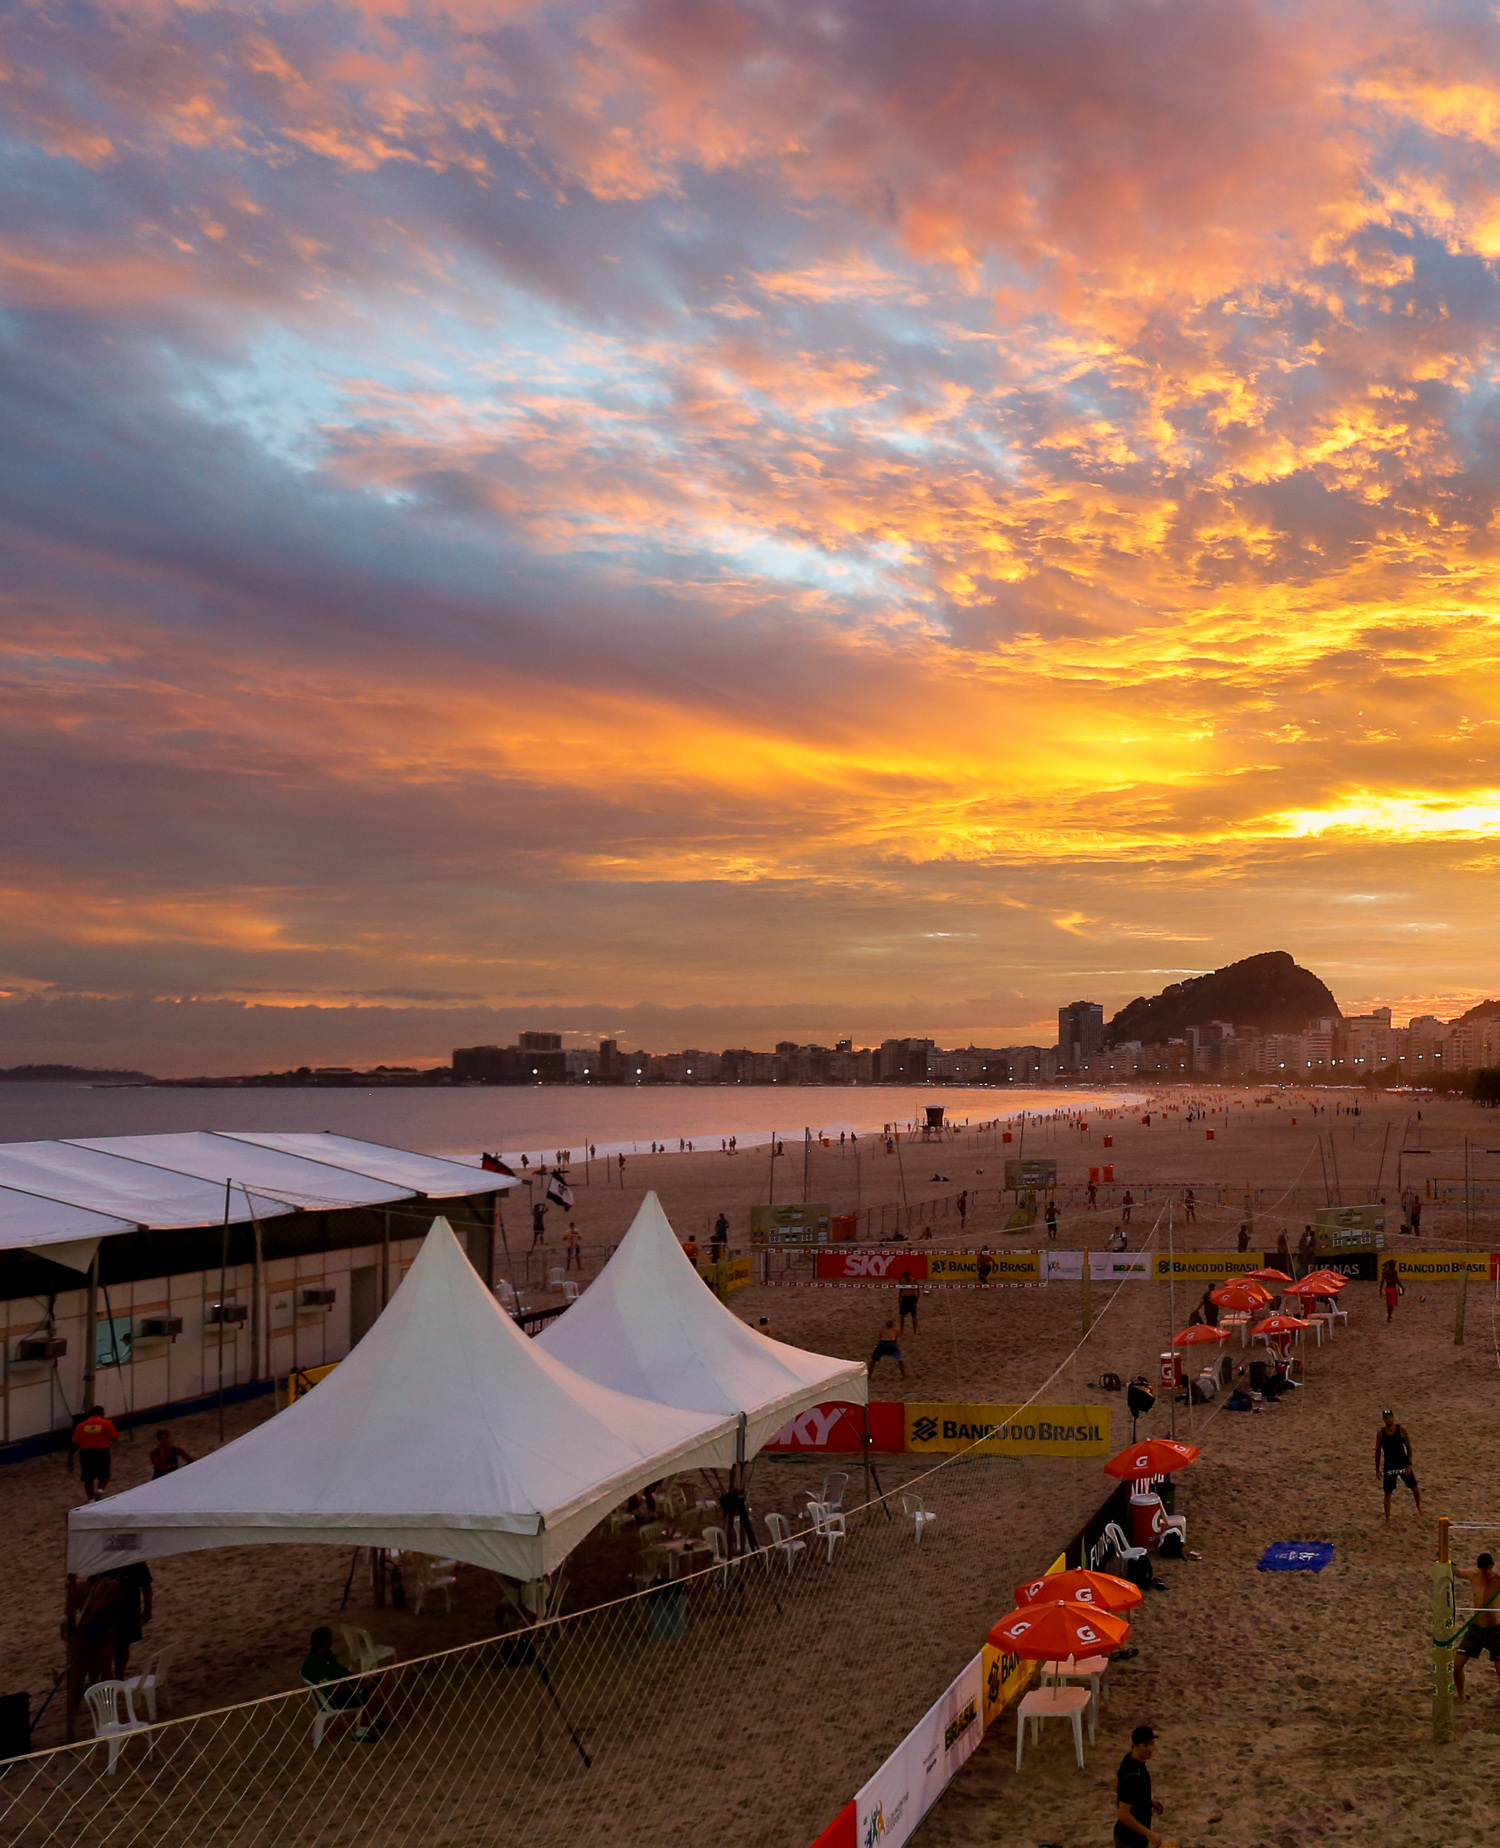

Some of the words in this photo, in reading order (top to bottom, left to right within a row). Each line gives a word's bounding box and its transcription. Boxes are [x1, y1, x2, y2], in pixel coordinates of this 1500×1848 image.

[843, 1255, 895, 1276] SKY
[949, 1261, 984, 1272] BANC
[1000, 1261, 1035, 1272] BRASIL
[1173, 1262, 1210, 1272] BANCO
[1213, 1264, 1224, 1272] DO
[1400, 1263, 1434, 1272] BANCO
[1437, 1264, 1450, 1272] DO
[1452, 1262, 1487, 1272] BASIL
[943, 1421, 1008, 1440] BANCO
[1010, 1424, 1036, 1440] DO
[1038, 1422, 1103, 1442] BRASIL
[1010, 1622, 1032, 1636] G
[1076, 1626, 1096, 1640] G
